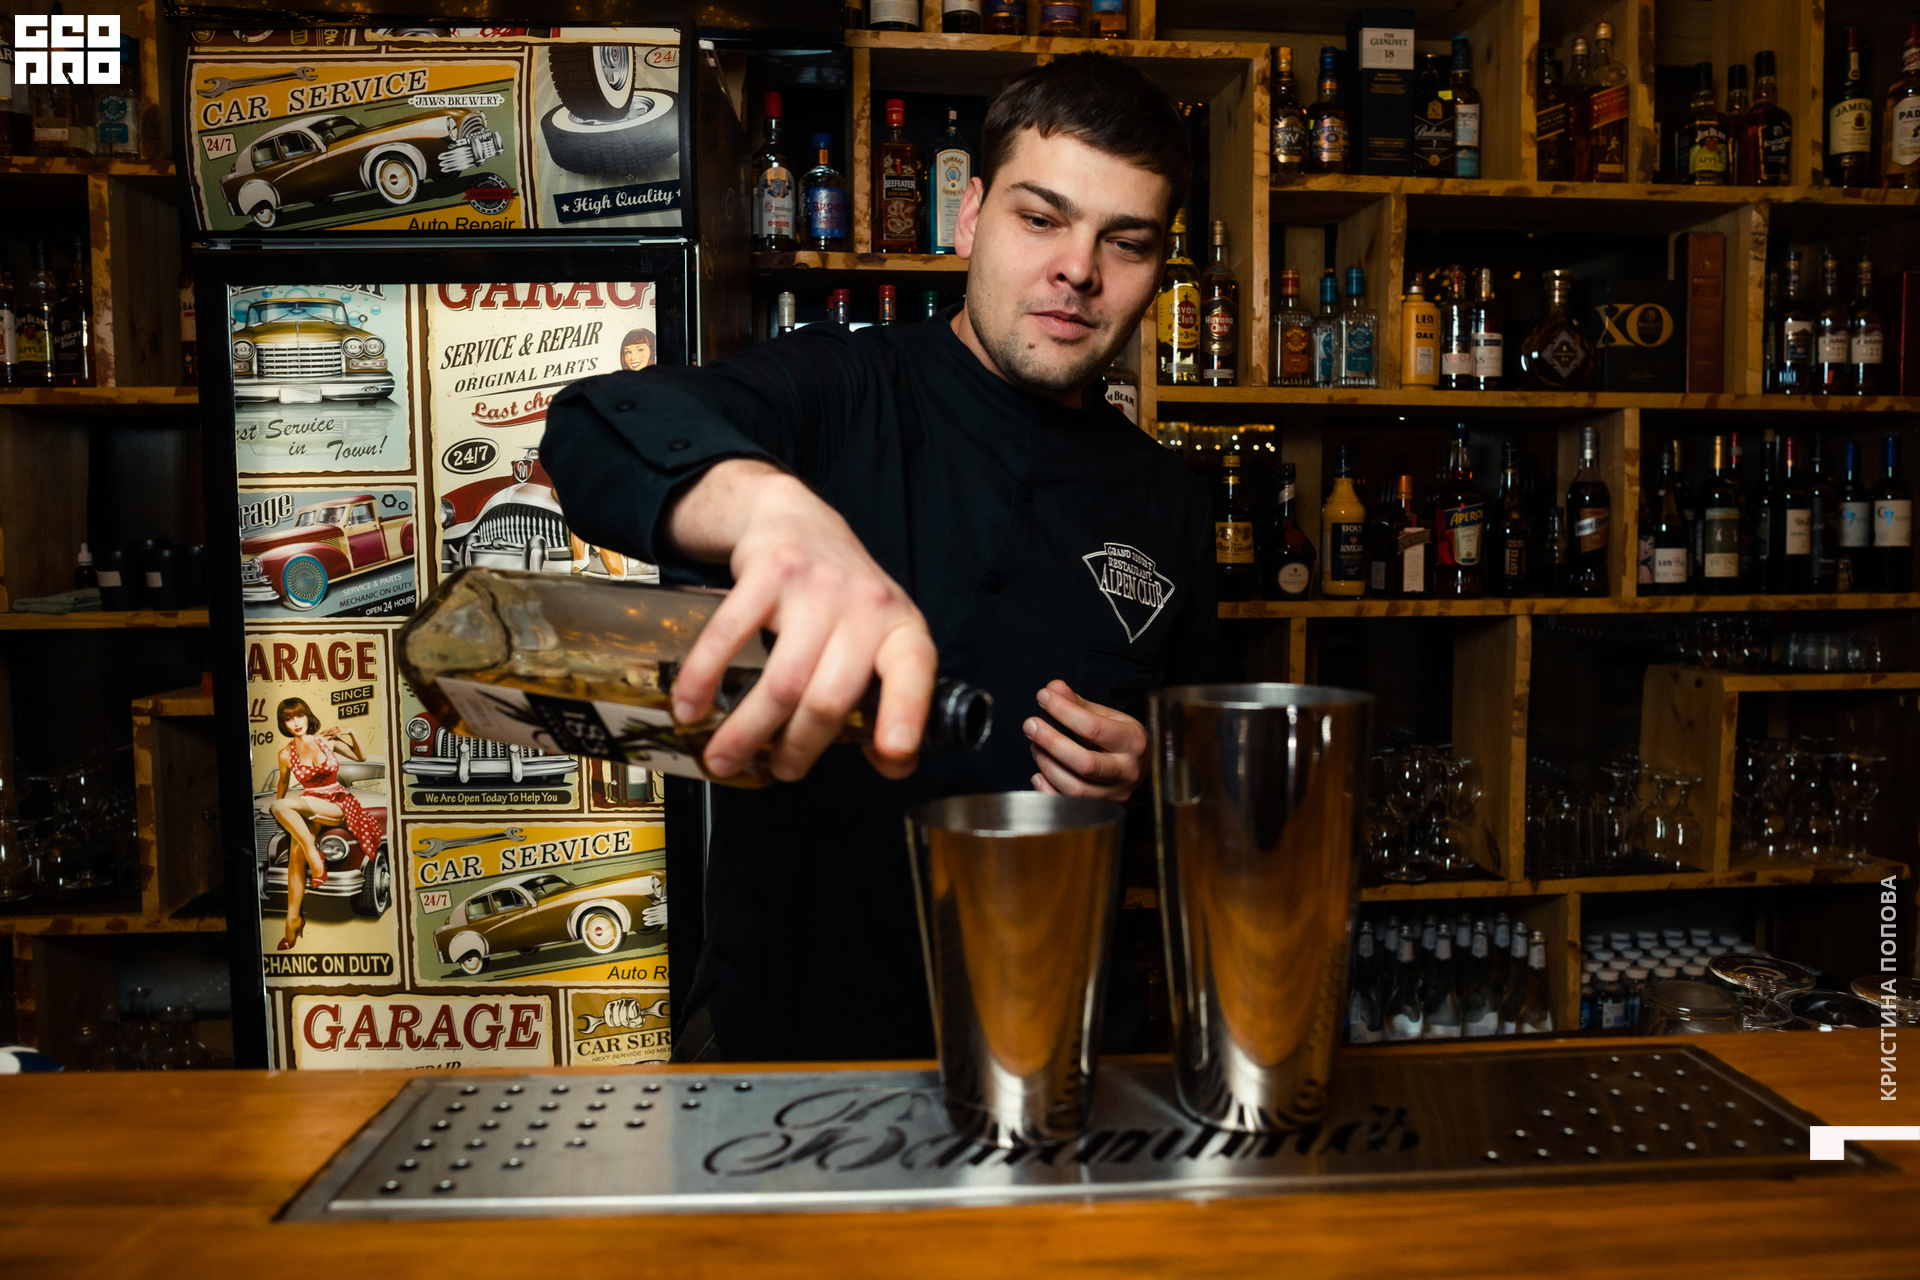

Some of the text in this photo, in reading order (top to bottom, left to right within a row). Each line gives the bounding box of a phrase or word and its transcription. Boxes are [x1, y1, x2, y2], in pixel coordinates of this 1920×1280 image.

[1370, 38, 1407, 46] GLENLIVET
[653, 50, 680, 64] 24/
[1384, 49, 1395, 58] 18
[203, 70, 428, 126] CAR SERVICE
[415, 95, 499, 106] JAWS BREWERY
[206, 138, 232, 151] 24/7
[884, 179, 916, 189] BEEFEATER
[572, 187, 675, 215] High Quality
[408, 217, 516, 229] Auto Repair
[437, 283, 656, 311] GARAG
[1205, 315, 1234, 324] Havana
[1211, 323, 1229, 332] Club
[1594, 303, 1674, 348] XO
[1416, 331, 1434, 340] OAK
[440, 321, 603, 370] SERVICE & REPAIR
[455, 357, 599, 393] ORIGINAL PARTS
[1114, 390, 1134, 407] BEAM
[471, 401, 519, 420] Last
[265, 417, 335, 439] Service
[288, 435, 388, 462] in Town!
[453, 445, 489, 467] 24/7
[240, 493, 295, 530] rage
[1107, 546, 1131, 559] GRAND
[1108, 556, 1153, 582] RESTAURANT
[339, 581, 413, 608] MECHANIC ON DUTY
[342, 573, 403, 597] SERVICE & PARTS
[1100, 563, 1164, 609] ALPEN CLUB
[365, 595, 416, 616] OPEN 24 HOURS
[247, 641, 378, 682] ARAGE
[332, 686, 371, 703] SINCE
[339, 703, 367, 717] 1957
[425, 792, 558, 806] We Are Open Today To Help You
[420, 831, 631, 884] CAR SERVICE
[423, 894, 448, 907] 24/7
[321, 955, 345, 974] ON
[348, 955, 390, 974] DUTY
[607, 966, 669, 980] Auto R
[303, 1002, 542, 1051] GARAGE
[577, 1030, 671, 1056] CAR SER
[592, 1054, 611, 1062] NEXT
[611, 1051, 642, 1060] SERVICE
